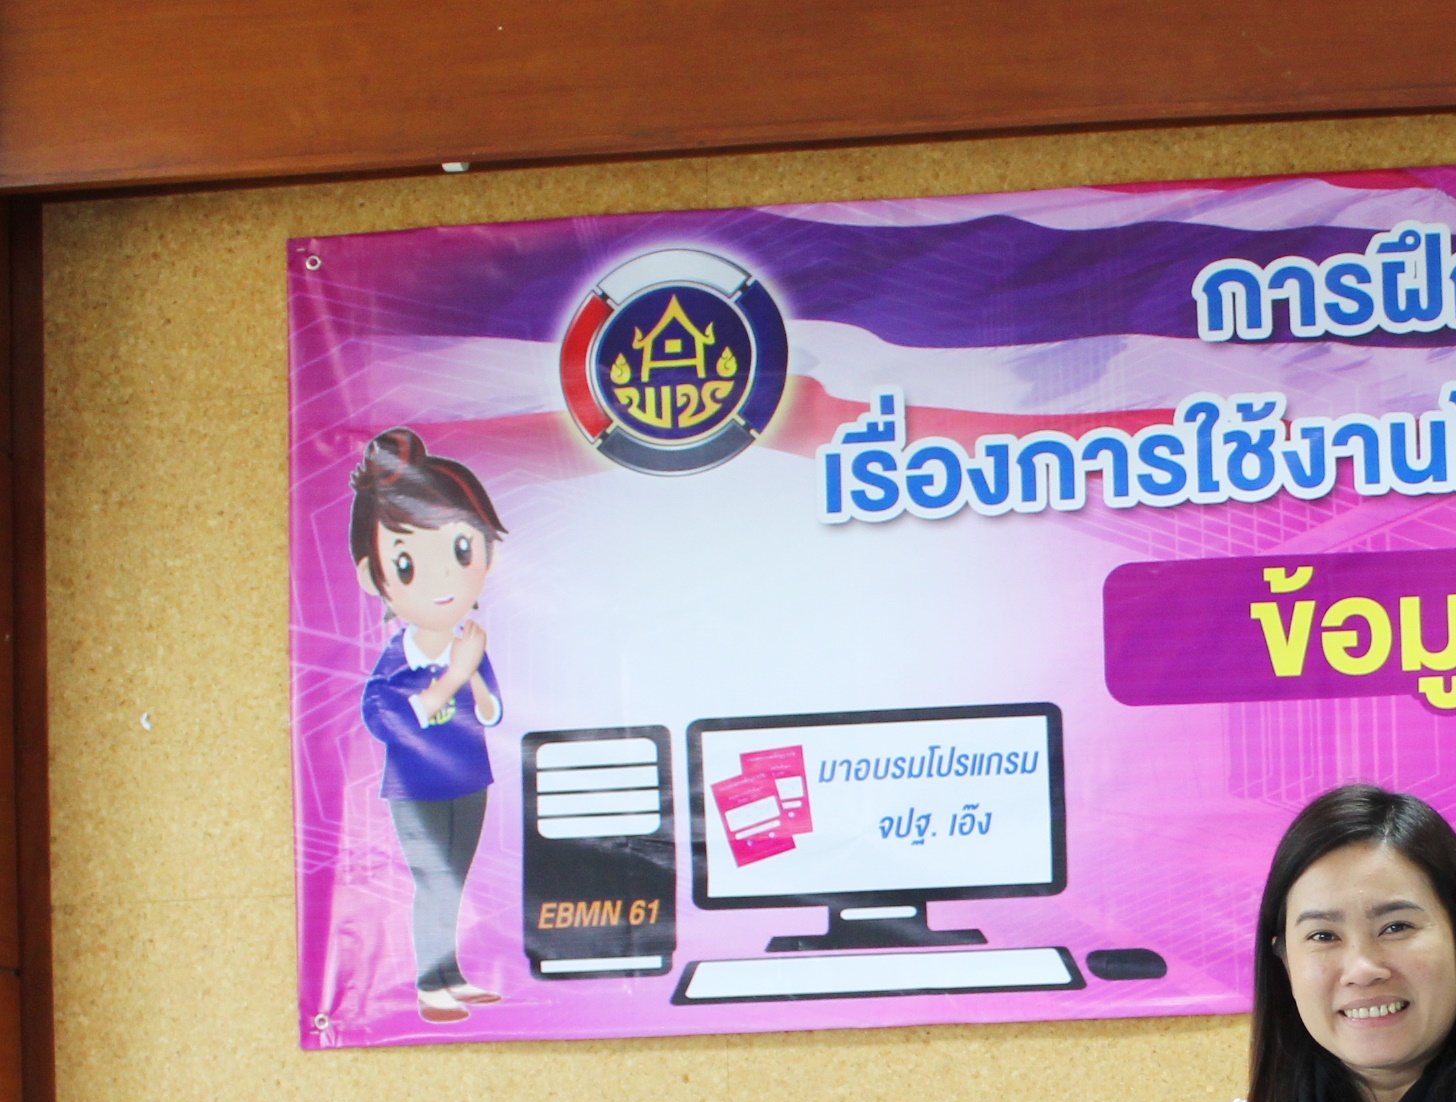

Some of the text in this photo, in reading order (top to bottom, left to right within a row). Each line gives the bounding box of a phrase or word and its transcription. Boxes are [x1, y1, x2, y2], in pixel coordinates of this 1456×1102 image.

[817, 744, 1040, 784] มาอบรมโปรแกรม
[877, 806, 938, 847] จปฐ.
[537, 898, 660, 930] EBMN 61
